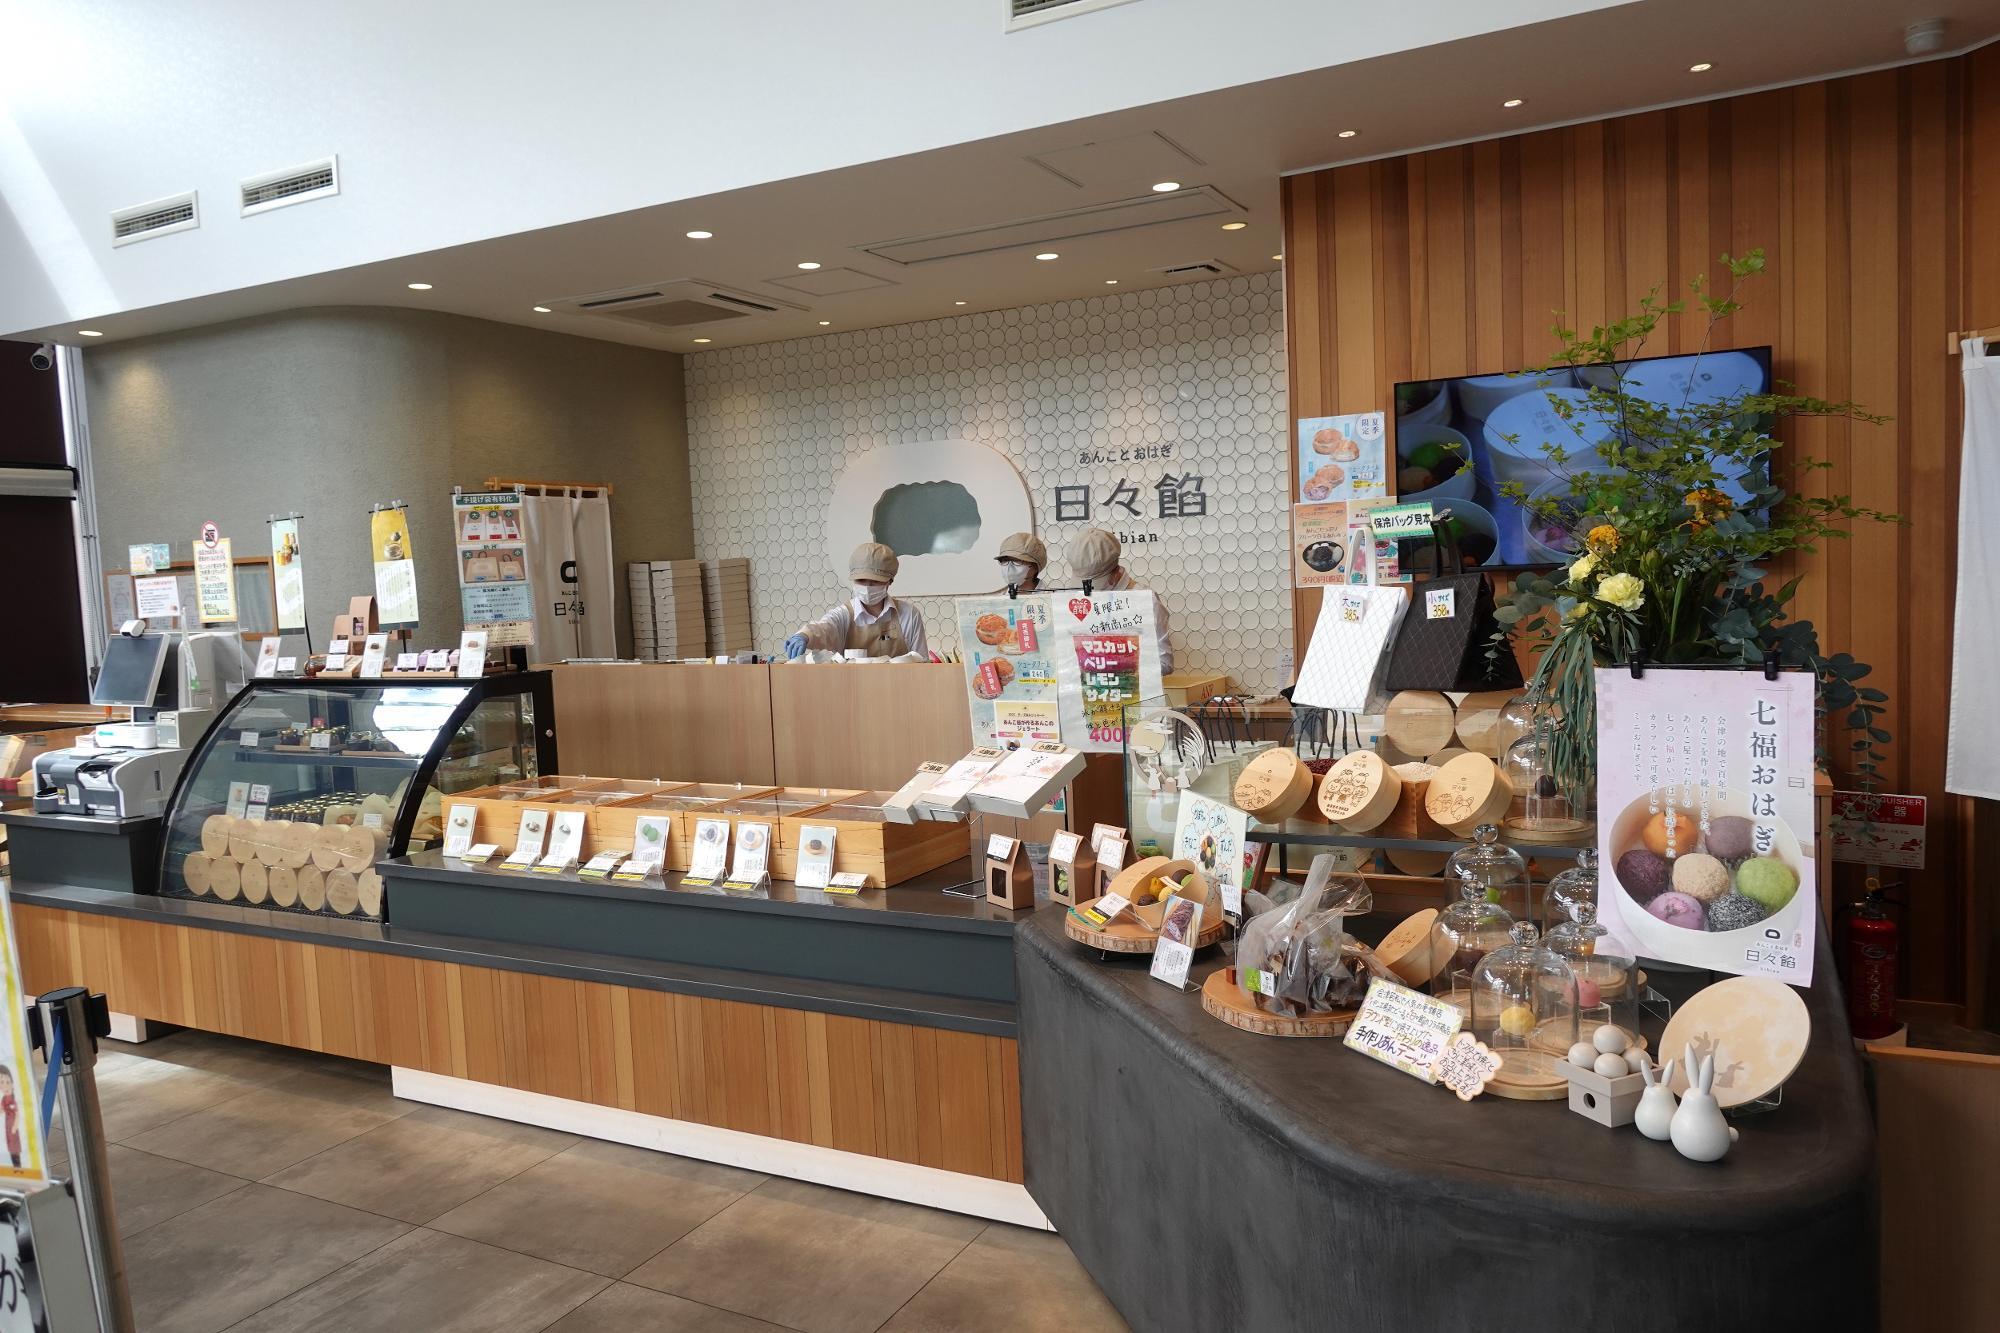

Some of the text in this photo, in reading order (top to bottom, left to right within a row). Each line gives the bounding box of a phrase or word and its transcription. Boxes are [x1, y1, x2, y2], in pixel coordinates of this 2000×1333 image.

[1079, 443, 1174, 465] あんことおはぎ
[1055, 472, 1206, 521] 日々餡
[1373, 512, 1432, 529] 保冷バッグ見本
[1112, 531, 1159, 544] bian
[1081, 640, 1138, 654] マスカット
[1084, 657, 1118, 670] ベリー
[1085, 672, 1120, 686] レモン
[1086, 688, 1133, 702] サイダー
[1717, 715, 1727, 801] 会津の地で百年間
[1749, 699, 1777, 853] 七福おはぎ
[1746, 949, 1796, 969] 日々餡
